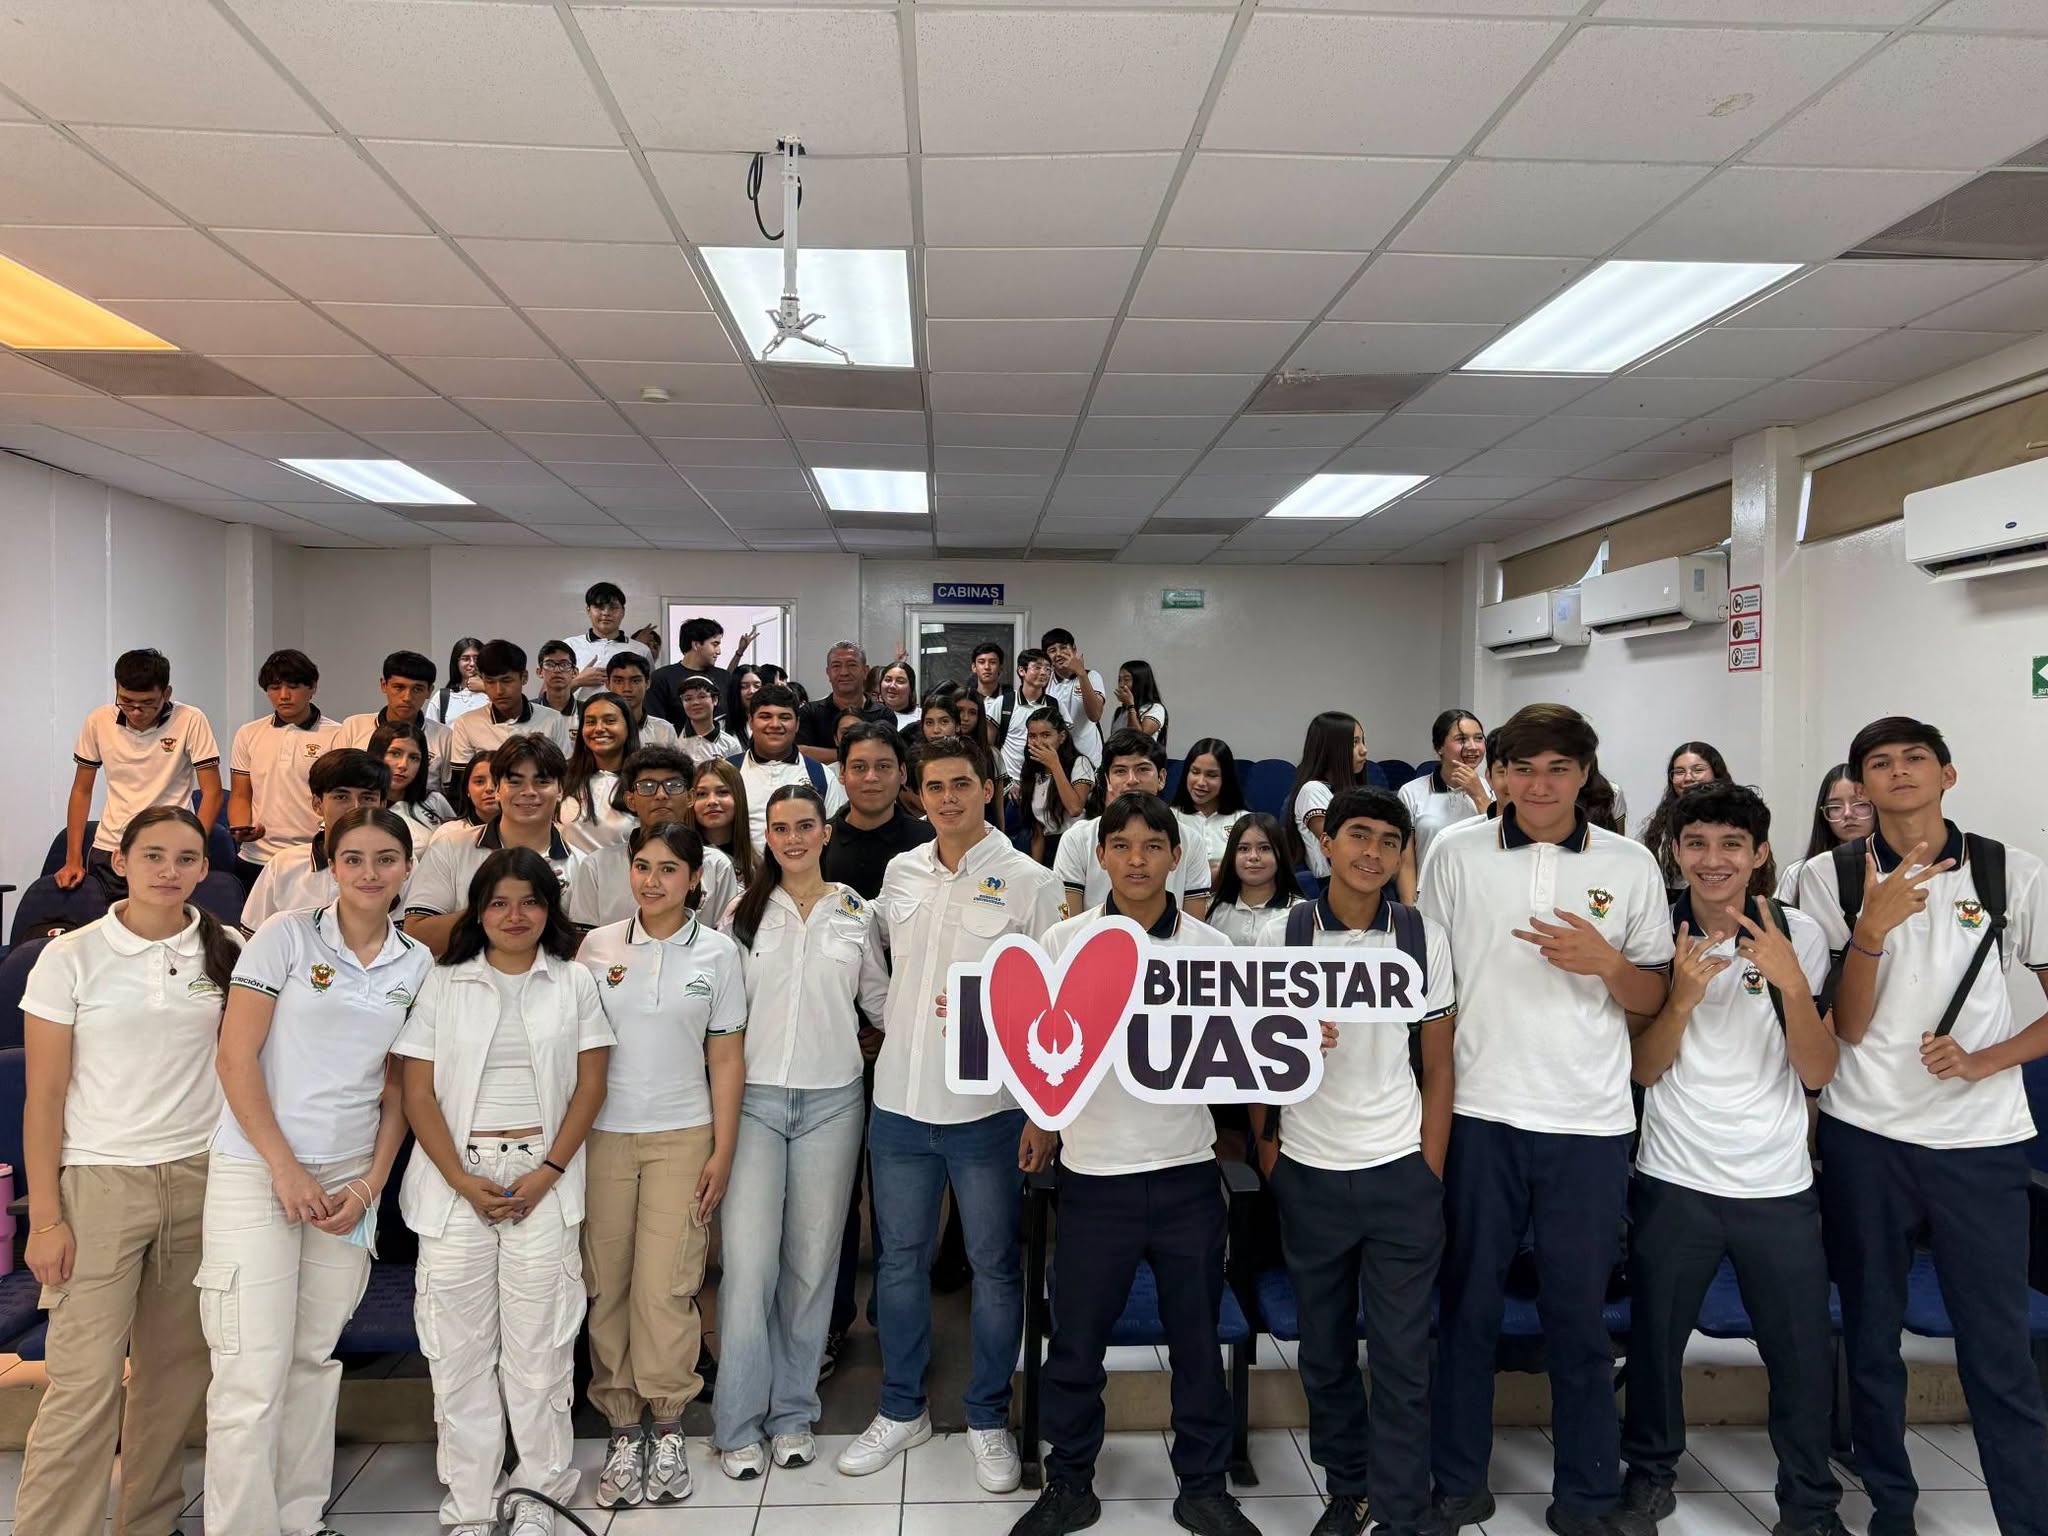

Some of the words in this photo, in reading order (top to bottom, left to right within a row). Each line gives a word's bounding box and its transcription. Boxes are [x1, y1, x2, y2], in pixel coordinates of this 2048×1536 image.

[937, 586, 999, 598] CABINAS
[1143, 959, 1413, 1008] BIENESTAR
[959, 975, 989, 1080] I
[1127, 1013, 1311, 1093] UAS
